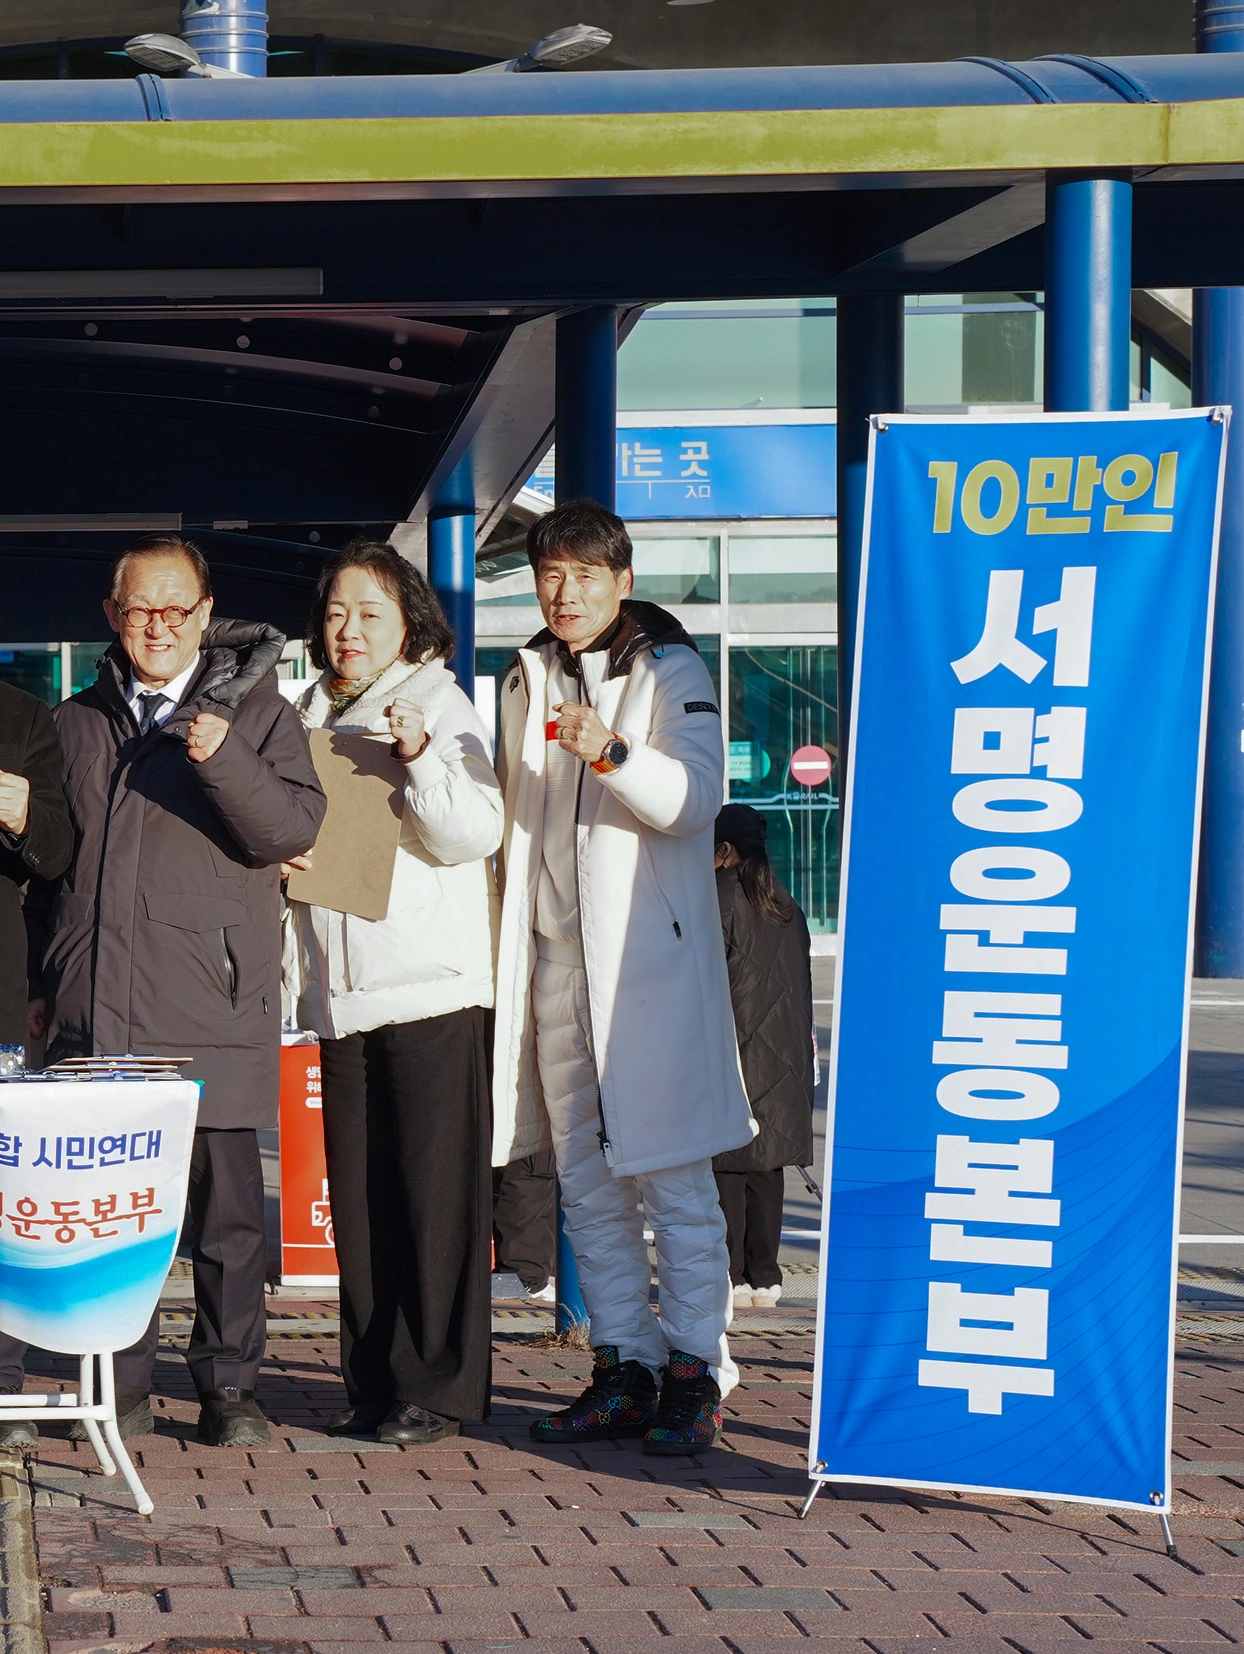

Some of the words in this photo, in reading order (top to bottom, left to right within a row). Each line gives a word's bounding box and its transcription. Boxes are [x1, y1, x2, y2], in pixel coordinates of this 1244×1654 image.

[680, 441, 709, 477] 곳
[927, 450, 1179, 536] 10만인
[917, 565, 1097, 1416] 서명운동본부
[32, 1129, 162, 1170] 시민연대
